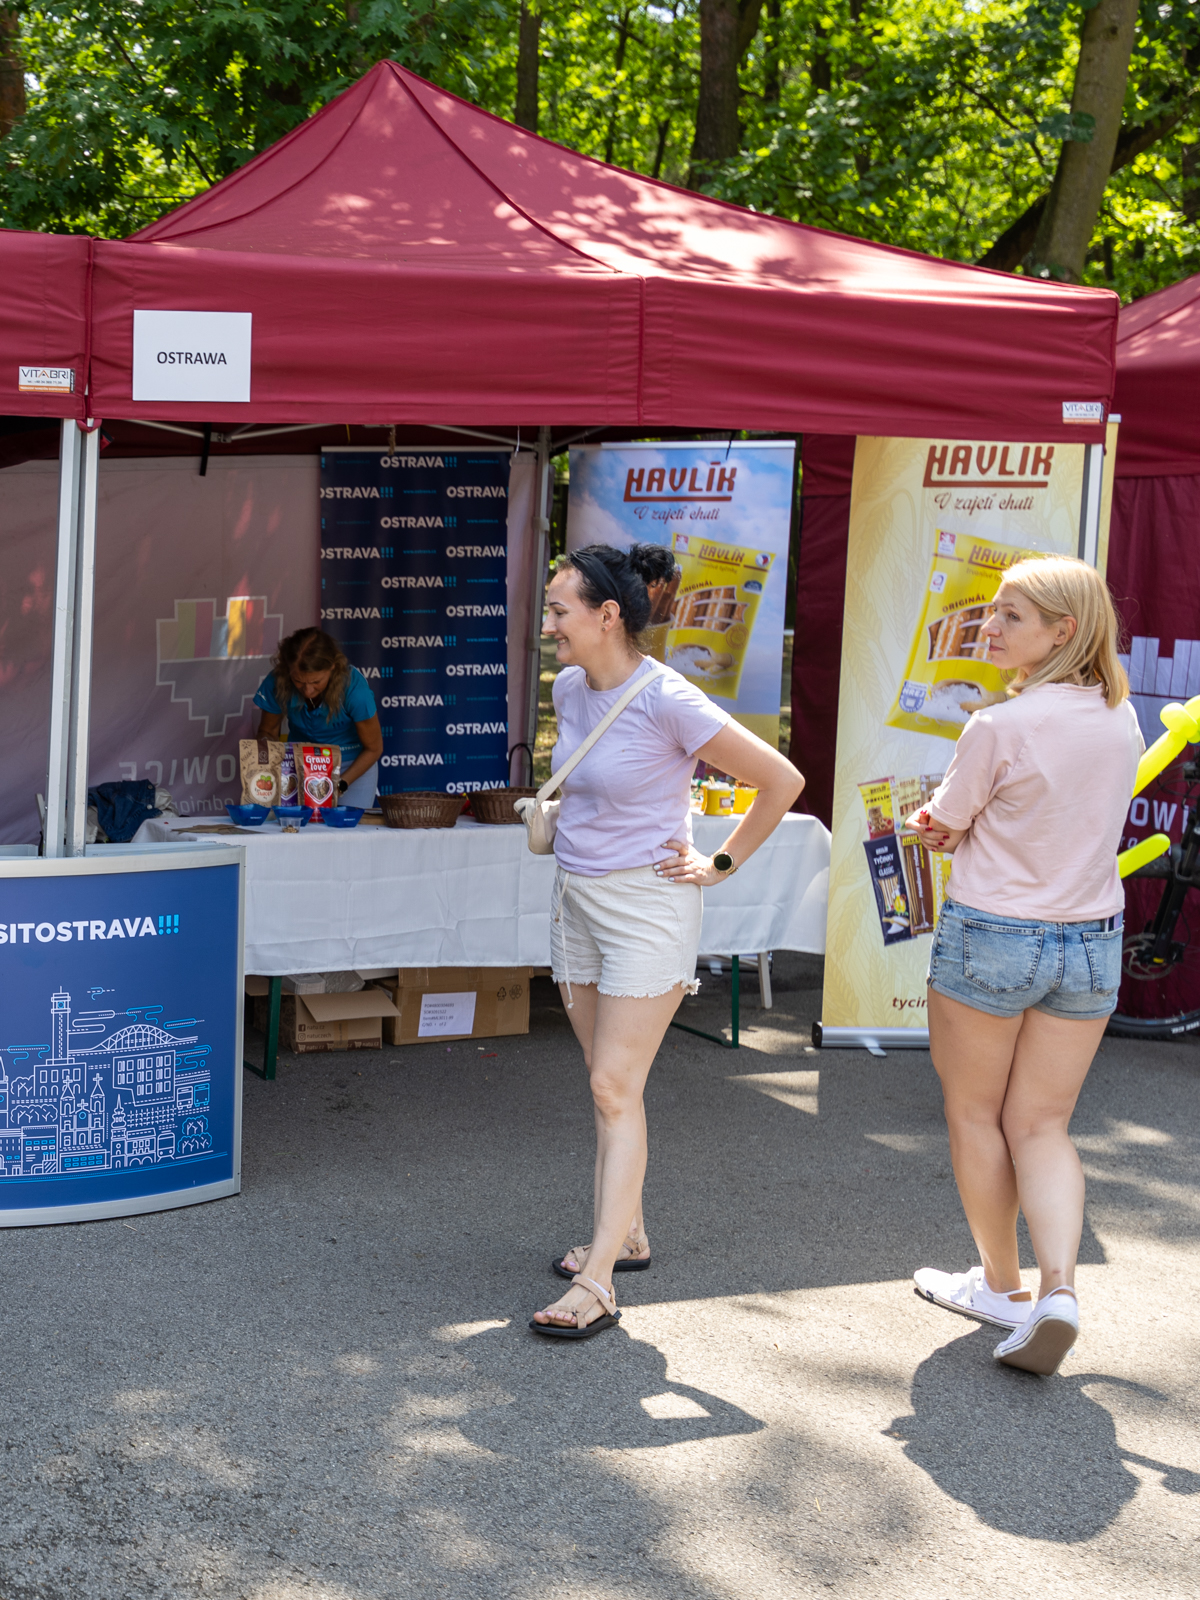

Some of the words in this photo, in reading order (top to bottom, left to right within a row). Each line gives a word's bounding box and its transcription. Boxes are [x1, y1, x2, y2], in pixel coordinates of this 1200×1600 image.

[157, 351, 227, 365] OSTRAWA
[21, 368, 68, 379] VITABRI
[380, 456, 457, 468] OSTRAVA!!!
[624, 461, 737, 502] HAVLÍK
[381, 516, 457, 528] OSTRAVA!!!
[968, 544, 1026, 570] HAVLÍ
[381, 576, 456, 588] OSTRAVA!!!
[942, 594, 986, 614] ORIGINÁL
[381, 636, 456, 648] OSTRAVA!!!
[382, 695, 456, 707] OSTRAVA!!!
[306, 756, 330, 764] Grano
[381, 754, 456, 766] OSTRAVA!!!
